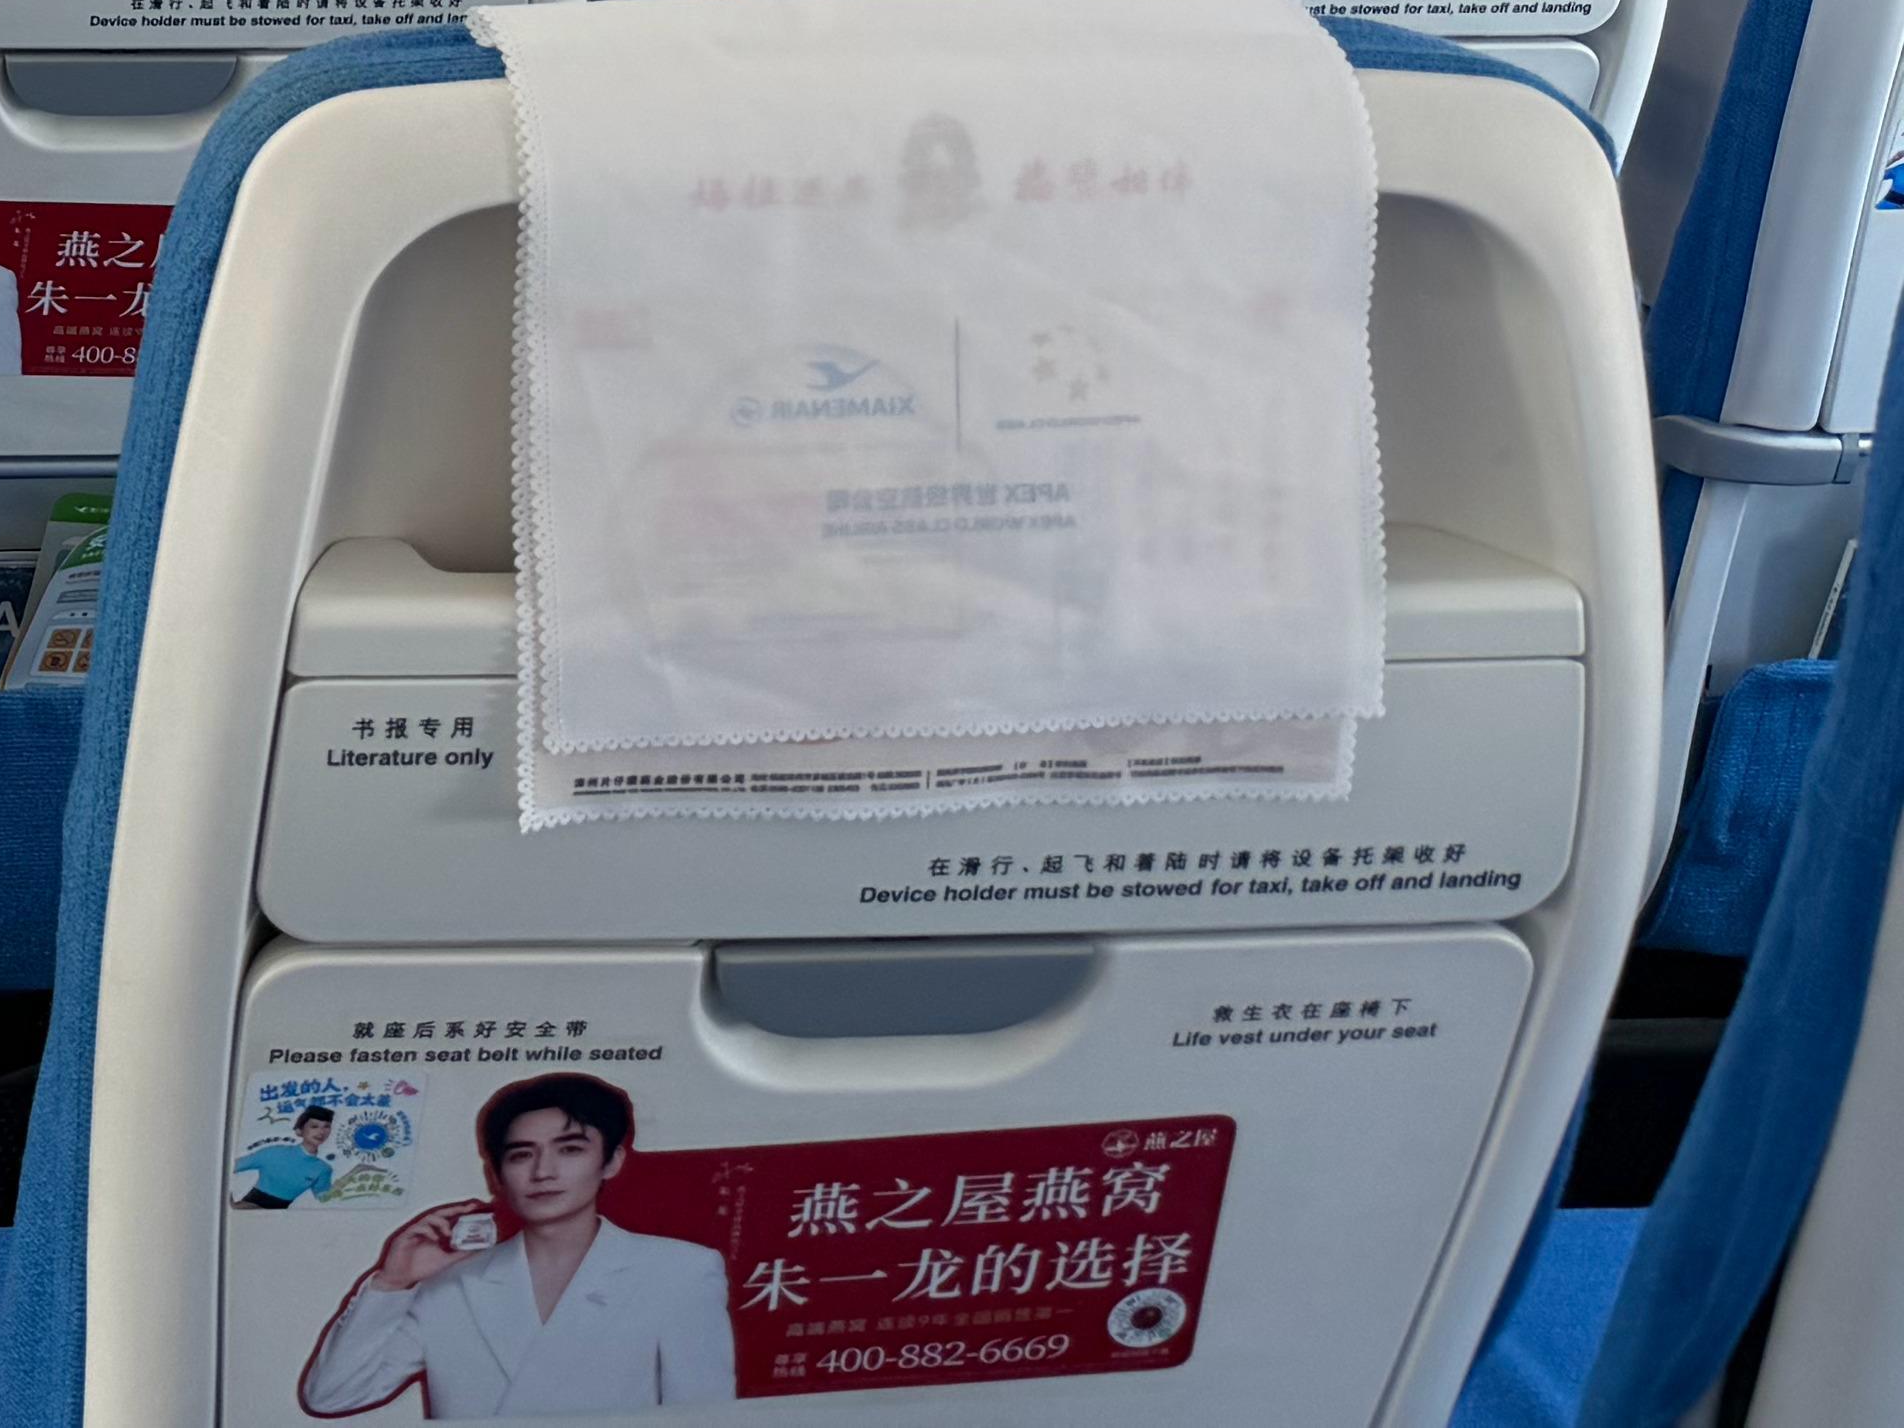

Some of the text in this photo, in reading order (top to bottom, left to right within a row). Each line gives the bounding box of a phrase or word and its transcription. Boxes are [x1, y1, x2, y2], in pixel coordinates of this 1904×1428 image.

[352, 717, 474, 739] 书报专用
[327, 749, 494, 769] Literature only
[927, 844, 1467, 877] 在滑行、起飞和着陆时请将设备托架收好
[860, 869, 1522, 904] Device holder must be stowed for taxi, take off and landing
[1213, 999, 1414, 1024] 救生衣在座椅下
[352, 1020, 589, 1040] 就座后系好安全带
[1172, 1022, 1438, 1048] Life vest under your seat
[269, 1046, 662, 1064] Please fasten seat belt while seated
[1142, 1128, 1218, 1152] 燕之屋
[787, 1161, 1171, 1240] 燕之屋燕窝
[739, 1233, 1192, 1313] 朱一龙的选择
[816, 1333, 1071, 1373] 400-882-6669
